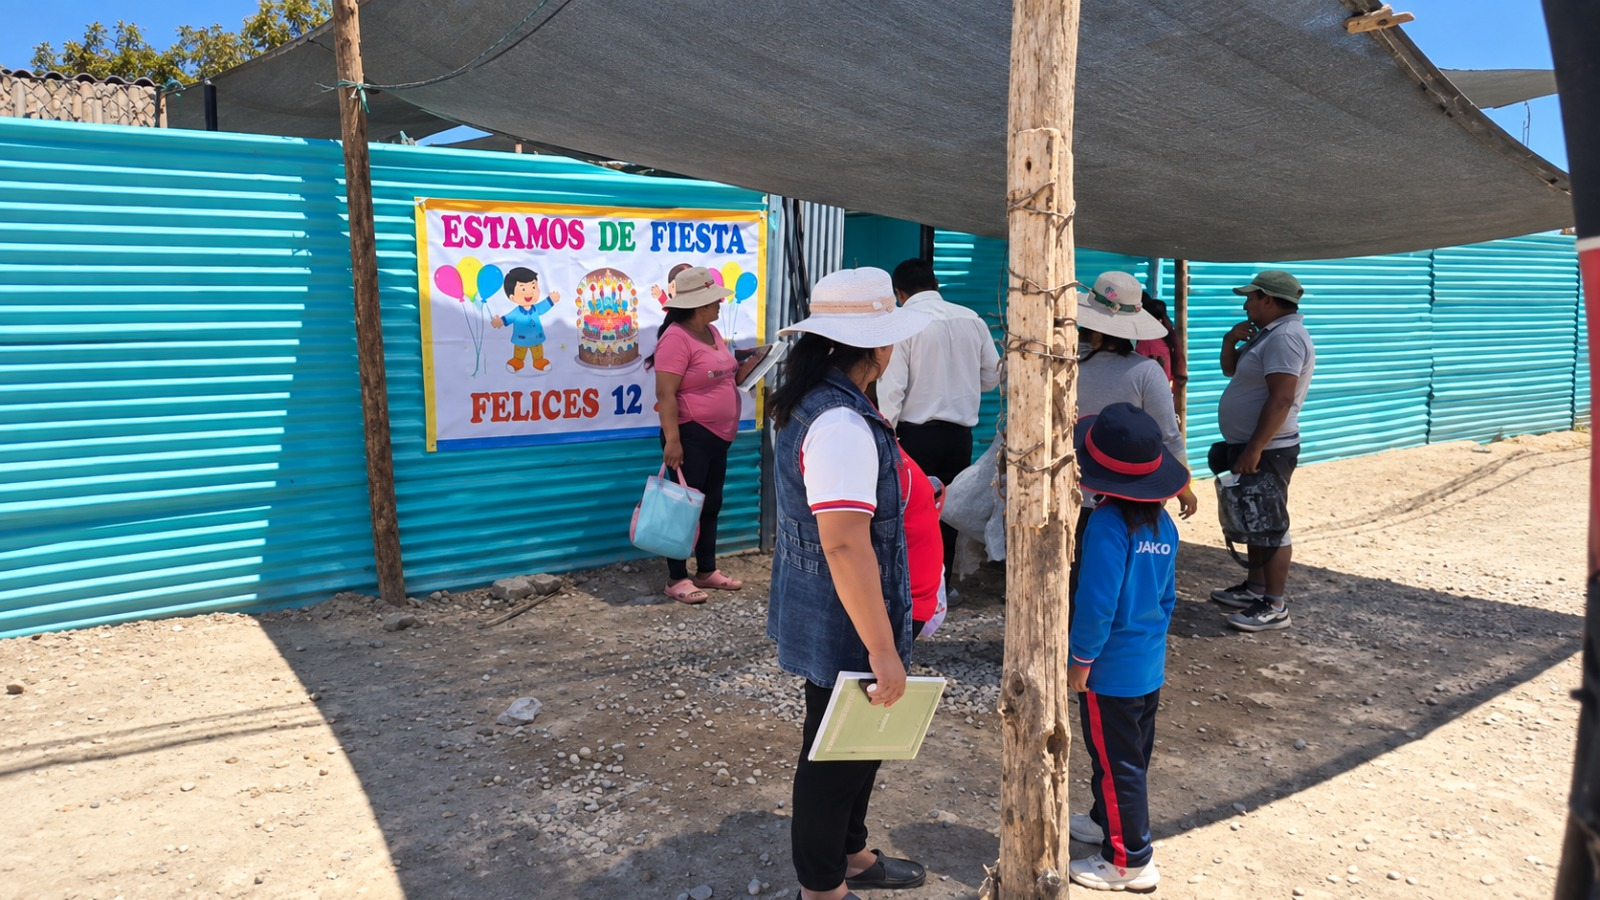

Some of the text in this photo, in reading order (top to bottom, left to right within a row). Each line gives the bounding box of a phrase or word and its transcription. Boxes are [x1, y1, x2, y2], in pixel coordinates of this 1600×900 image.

[442, 215, 747, 254] ESTAMOS DE FIESTA
[470, 388, 599, 423] FELICES
[612, 384, 642, 415] 12
[1136, 541, 1171, 555] JAKO
